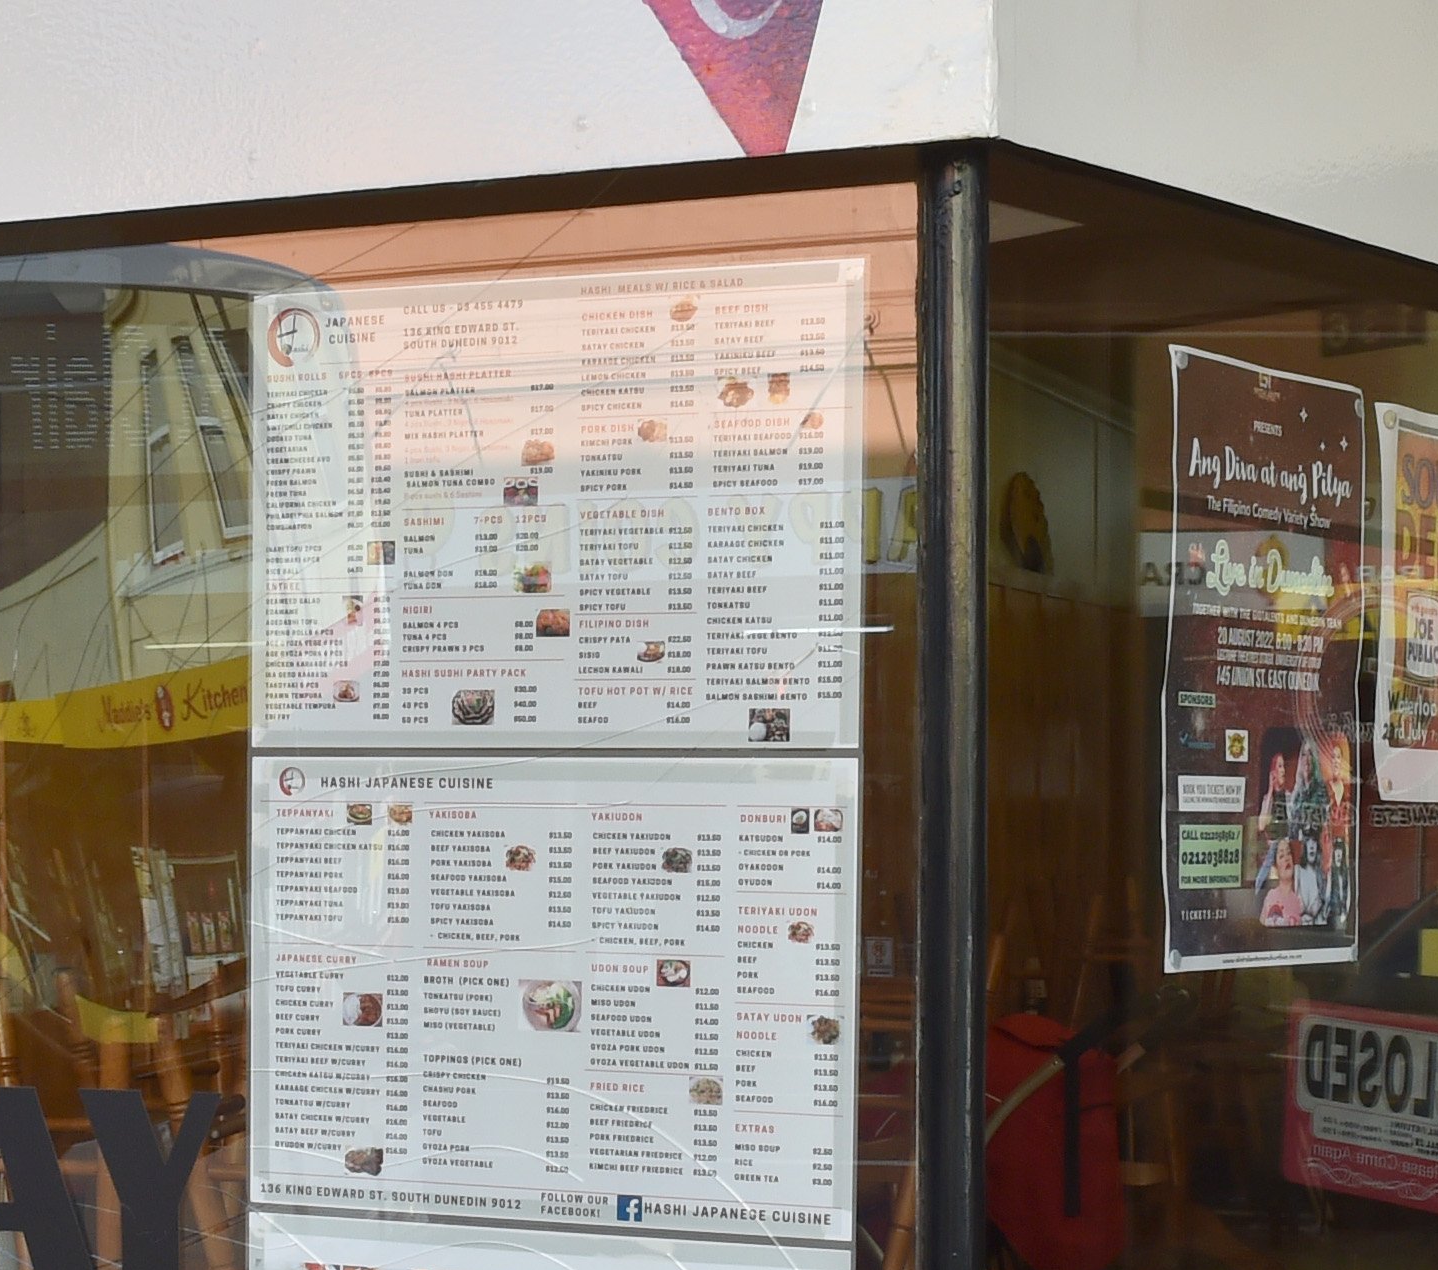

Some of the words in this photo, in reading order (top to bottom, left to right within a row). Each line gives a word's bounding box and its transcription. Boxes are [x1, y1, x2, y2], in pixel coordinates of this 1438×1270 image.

[618, 283, 651, 294] MEALS
[672, 280, 696, 290] RICE
[710, 278, 743, 288] SALAD
[403, 305, 426, 316] CALL
[430, 304, 447, 314] US
[497, 299, 524, 310] 4479
[325, 315, 385, 328] JAPANESE
[582, 311, 626, 322] CHICKEN
[329, 332, 376, 344] CUISINE
[581, 424, 606, 434] PORK
[1253, 421, 1282, 437] PRESENTS
[1189, 437, 1220, 489] Ang
[1225, 445, 1258, 483] Diva
[1261, 461, 1278, 488] at
[1280, 468, 1307, 505] ang
[1312, 460, 1353, 507] Pilya
[580, 509, 637, 520] VEGETABLE
[708, 506, 741, 516] BENTO
[745, 506, 765, 515] BOX
[1207, 495, 1221, 512] The
[1223, 497, 1250, 517] Filipino
[1253, 505, 1282, 524] Comedy
[1284, 510, 1308, 529] Variety
[1310, 514, 1331, 529] Show
[403, 606, 433, 615] NIGIRI
[1413, 616, 1434, 641] JOE
[402, 669, 431, 678] HASHI
[435, 669, 463, 678] SUSHI
[467, 669, 497, 678] PARTY
[501, 668, 527, 677] PACK
[578, 687, 604, 697] TOFU
[607, 687, 627, 697] HOT
[630, 687, 650, 696] POT
[670, 686, 693, 695] RICE
[321, 777, 360, 789] HASHI
[365, 777, 433, 789] JAPANESE
[439, 778, 494, 790] CUISINE
[277, 808, 334, 818] TEPPANYAKI
[429, 809, 477, 820] YAKISOBA
[591, 812, 643, 822] YAKIUDON
[740, 814, 786, 823] DONBURI
[1181, 829, 1199, 841] CALL
[738, 907, 785, 917] TERIYAKI
[789, 908, 818, 917] UDON
[737, 925, 778, 934] NOODLE
[276, 954, 323, 964] JAPANESE
[326, 955, 356, 964] CURRY
[426, 958, 460, 968] RAMEN
[463, 959, 488, 969] SOUP
[591, 964, 618, 973] UDON
[622, 965, 649, 974] SOUP
[423, 975, 454, 985] BROTH
[458, 976, 485, 987] (PICK
[487, 977, 510, 987] ONE)
[736, 1013, 770, 1022] SATAY
[773, 1013, 802, 1023] UDON
[736, 1031, 777, 1040] NOODLE
[423, 1054, 468, 1064] TOPPINGS
[471, 1055, 498, 1066] (PICK
[501, 1056, 522, 1068] ONE)
[590, 1083, 618, 1092] FRIED
[622, 1083, 645, 1093] RICE
[735, 1124, 775, 1134] EXTRAS
[260, 1184, 281, 1195] 136
[285, 1185, 312, 1196] KING
[316, 1186, 364, 1199] EDWARD
[369, 1189, 388, 1201] ST.
[392, 1190, 430, 1204] SOUTH
[435, 1193, 487, 1207] DUNEDIN
[491, 1197, 521, 1209] 9012
[541, 1193, 583, 1204] FOLLOW
[587, 1195, 609, 1205] OUR
[541, 1206, 601, 1218] FACEBOOK!
[644, 1203, 687, 1216] HASHI
[693, 1205, 766, 1221] JAPANESE
[772, 1210, 832, 1226] CUISINE
